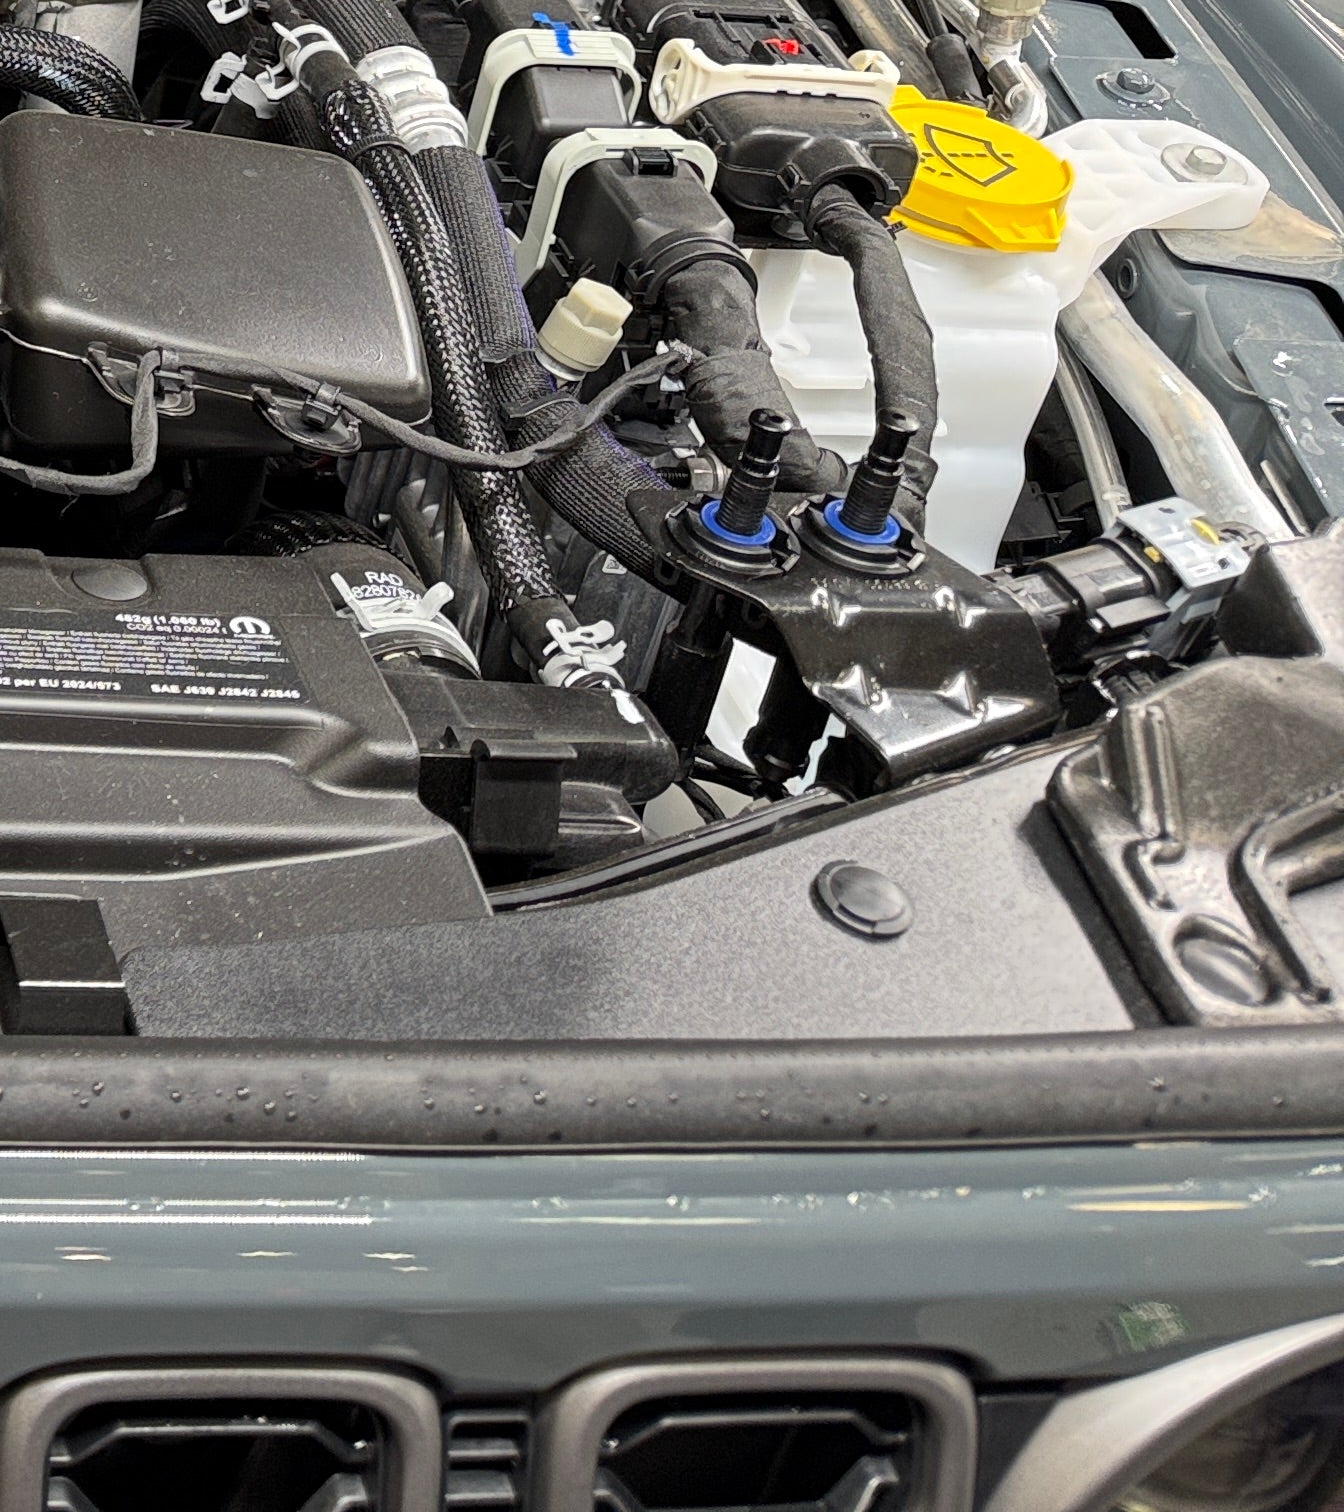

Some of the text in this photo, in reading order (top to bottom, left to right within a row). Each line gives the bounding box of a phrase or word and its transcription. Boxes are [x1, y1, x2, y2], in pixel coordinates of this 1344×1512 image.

[364, 571, 404, 587] RAD
[115, 613, 152, 625] 482g
[200, 616, 221, 628] lb)
[126, 623, 154, 632] CO2
[156, 625, 172, 634] eq
[14, 677, 36, 688] per
[38, 678, 60, 688] EU
[150, 684, 181, 694] SAE
[183, 686, 216, 696] J639
[218, 687, 258, 697] J2842
